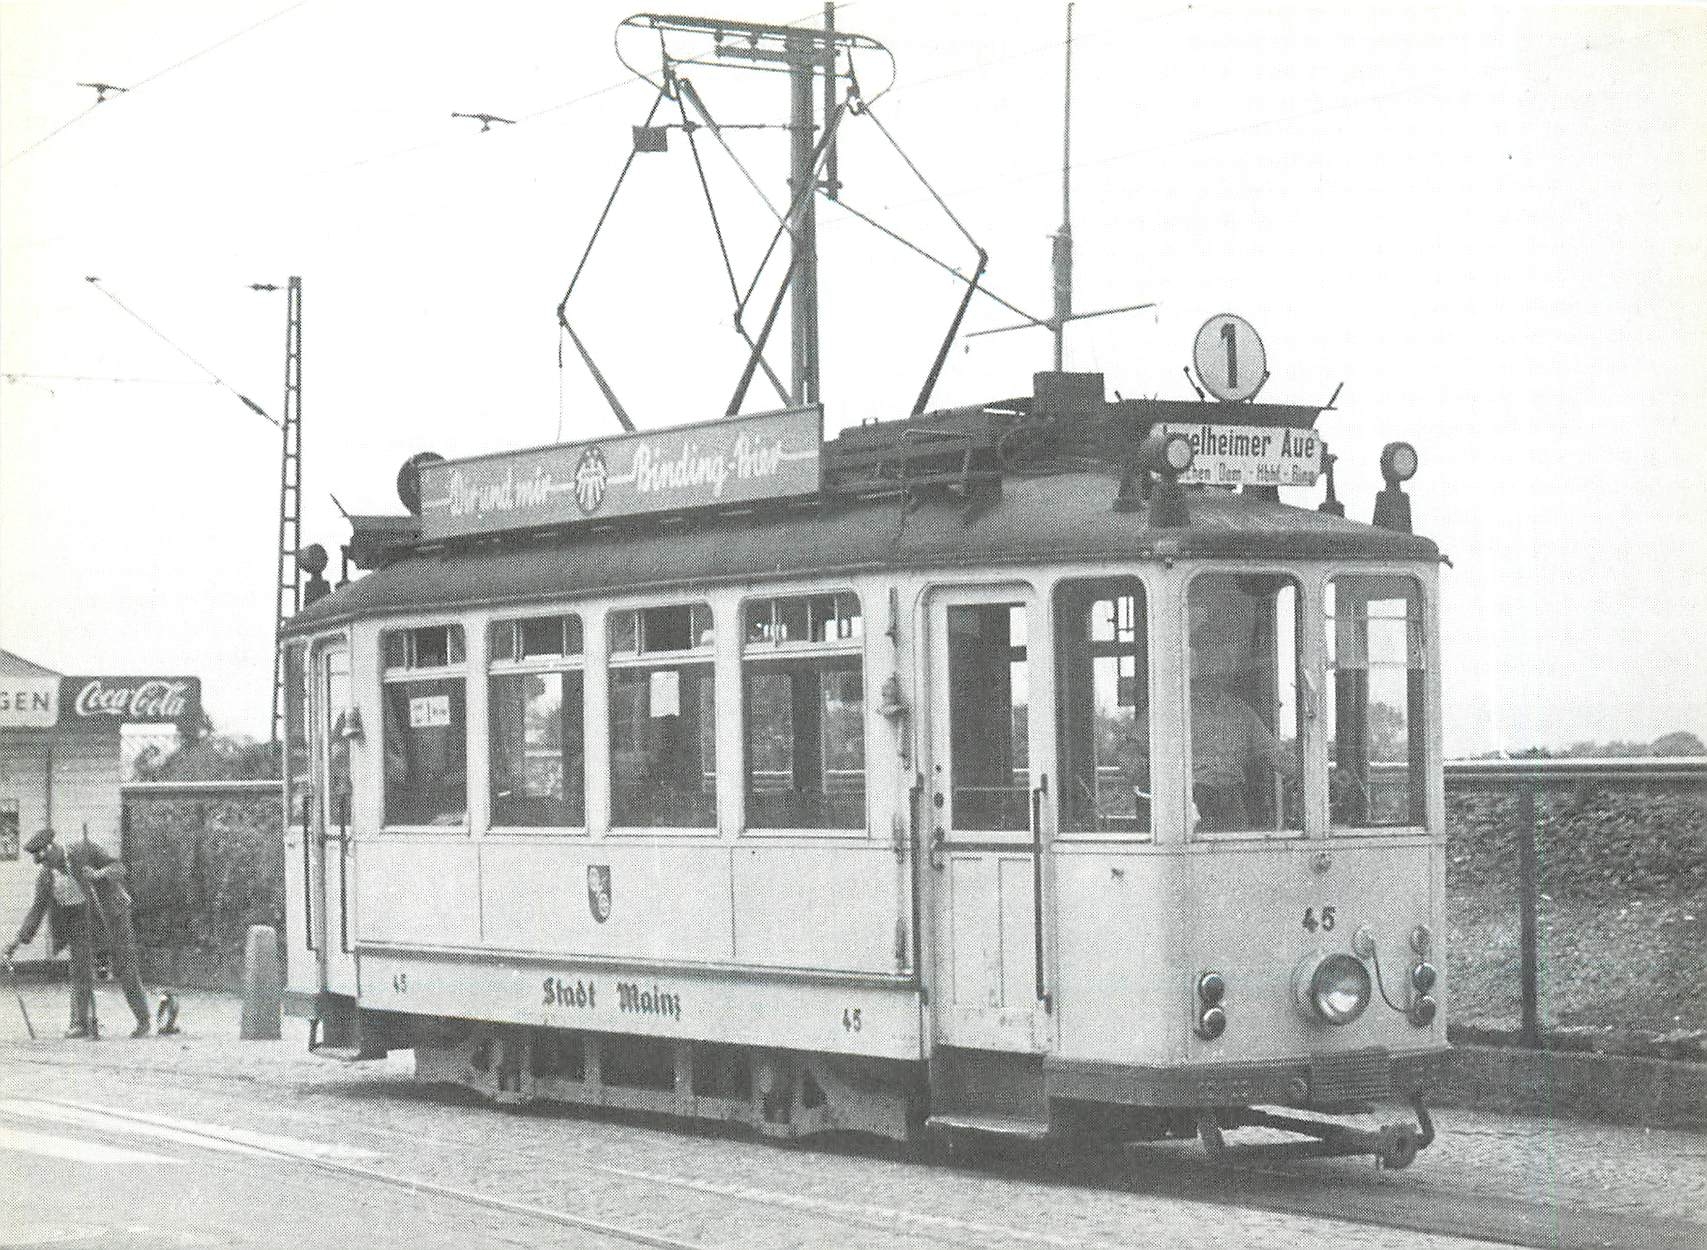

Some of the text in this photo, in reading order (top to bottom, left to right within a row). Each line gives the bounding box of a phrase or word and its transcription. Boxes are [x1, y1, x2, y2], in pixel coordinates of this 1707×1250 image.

[1220, 322, 1238, 389] 1
[1163, 424, 1315, 458] elheimer Aue
[479, 467, 514, 512] und
[515, 465, 552, 508] mir
[1302, 906, 1337, 934] 45
[392, 974, 408, 994] 45
[542, 976, 682, 1021] Stadt Mainz
[842, 1007, 863, 1033] 45
